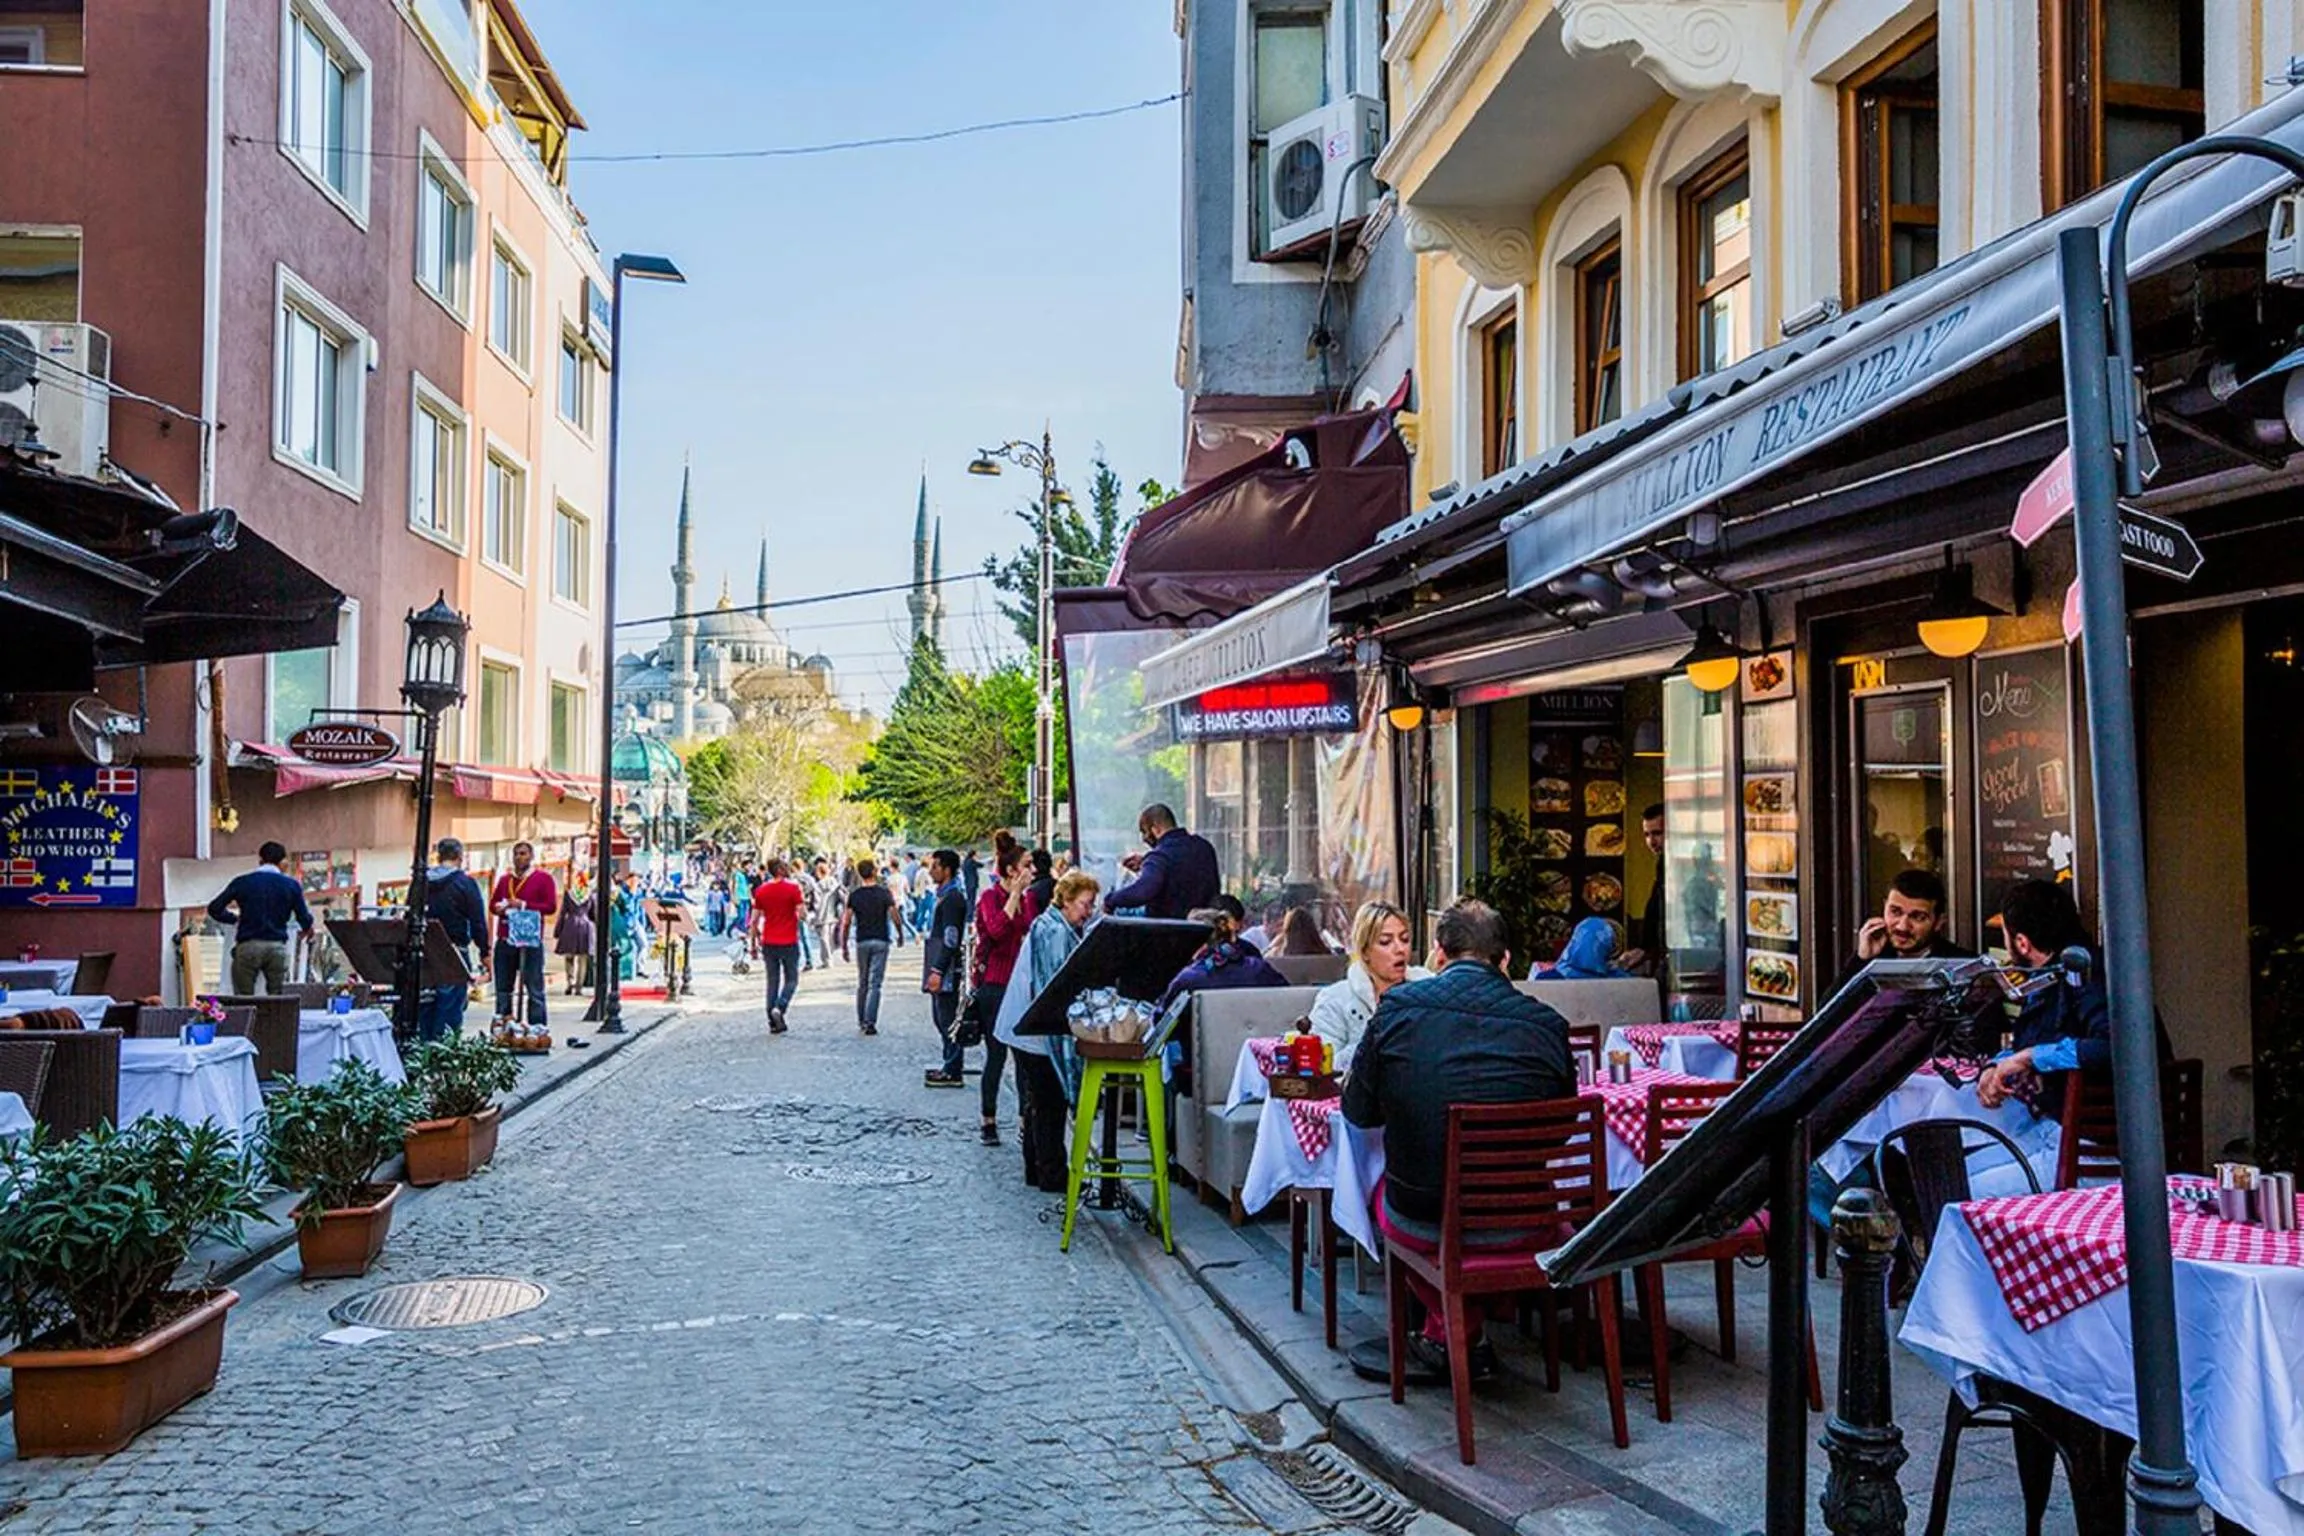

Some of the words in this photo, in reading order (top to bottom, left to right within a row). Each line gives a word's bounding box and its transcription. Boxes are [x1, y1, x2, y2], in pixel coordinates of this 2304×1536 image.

[1623, 426, 1735, 529] MILLION
[1751, 306, 1970, 463] RESTAURANT
[2118, 521, 2142, 548] AST
[2144, 529, 2175, 558] FOOD
[1181, 715, 1201, 733] WE
[1205, 711, 1241, 731] HAVE
[1242, 708, 1287, 728] SALON
[1290, 704, 1351, 727] UPSTAIRS
[22, 827, 105, 840] LEATHER
[9, 843, 116, 857] SHOWROOM
